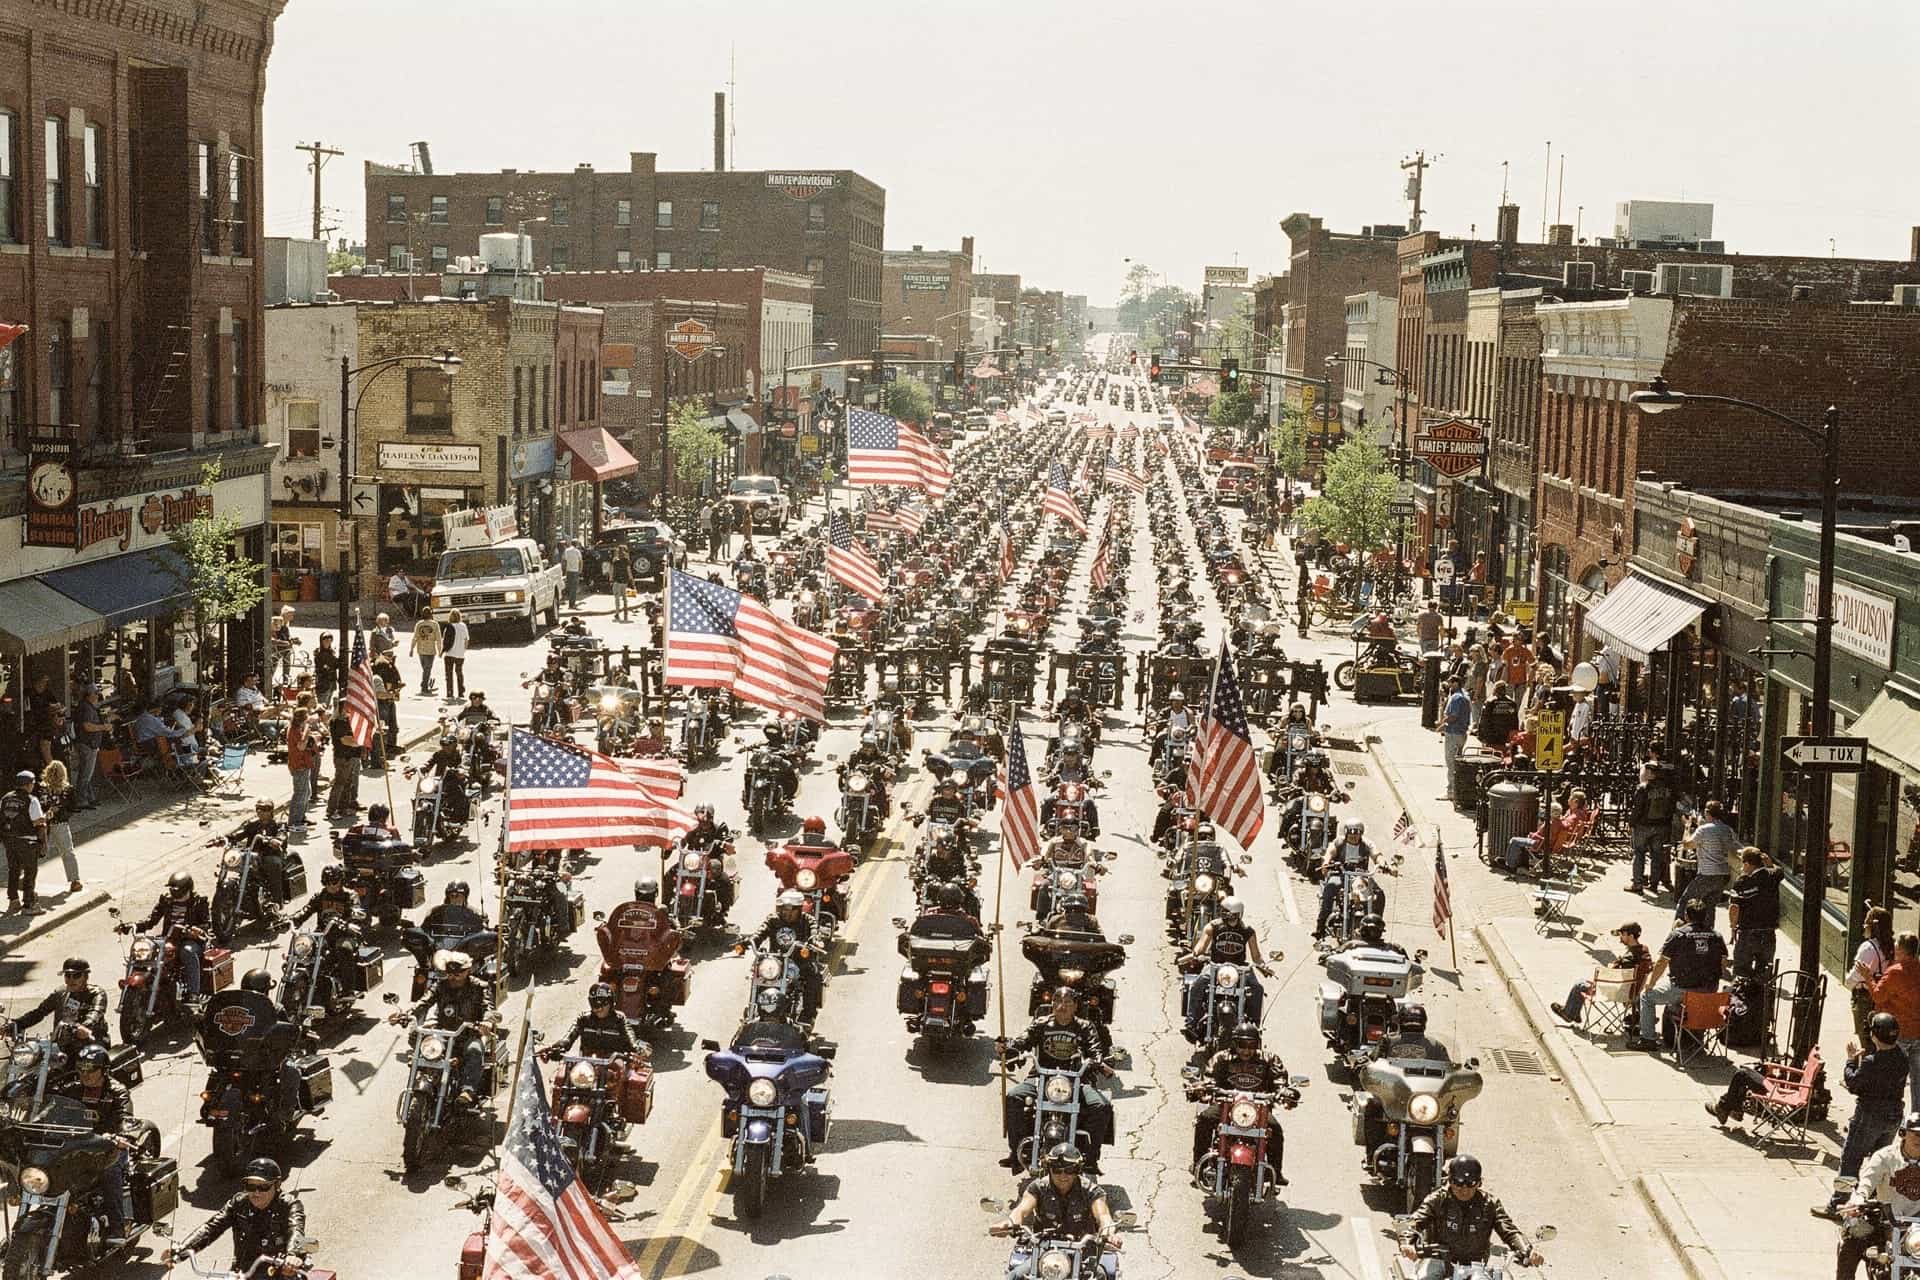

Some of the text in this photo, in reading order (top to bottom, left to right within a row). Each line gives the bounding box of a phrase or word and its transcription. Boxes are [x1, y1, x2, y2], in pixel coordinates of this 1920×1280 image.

[80, 502, 133, 551] Harley
[1842, 595, 1888, 644] DAVIDSON
[1829, 748, 1855, 761] TUX
